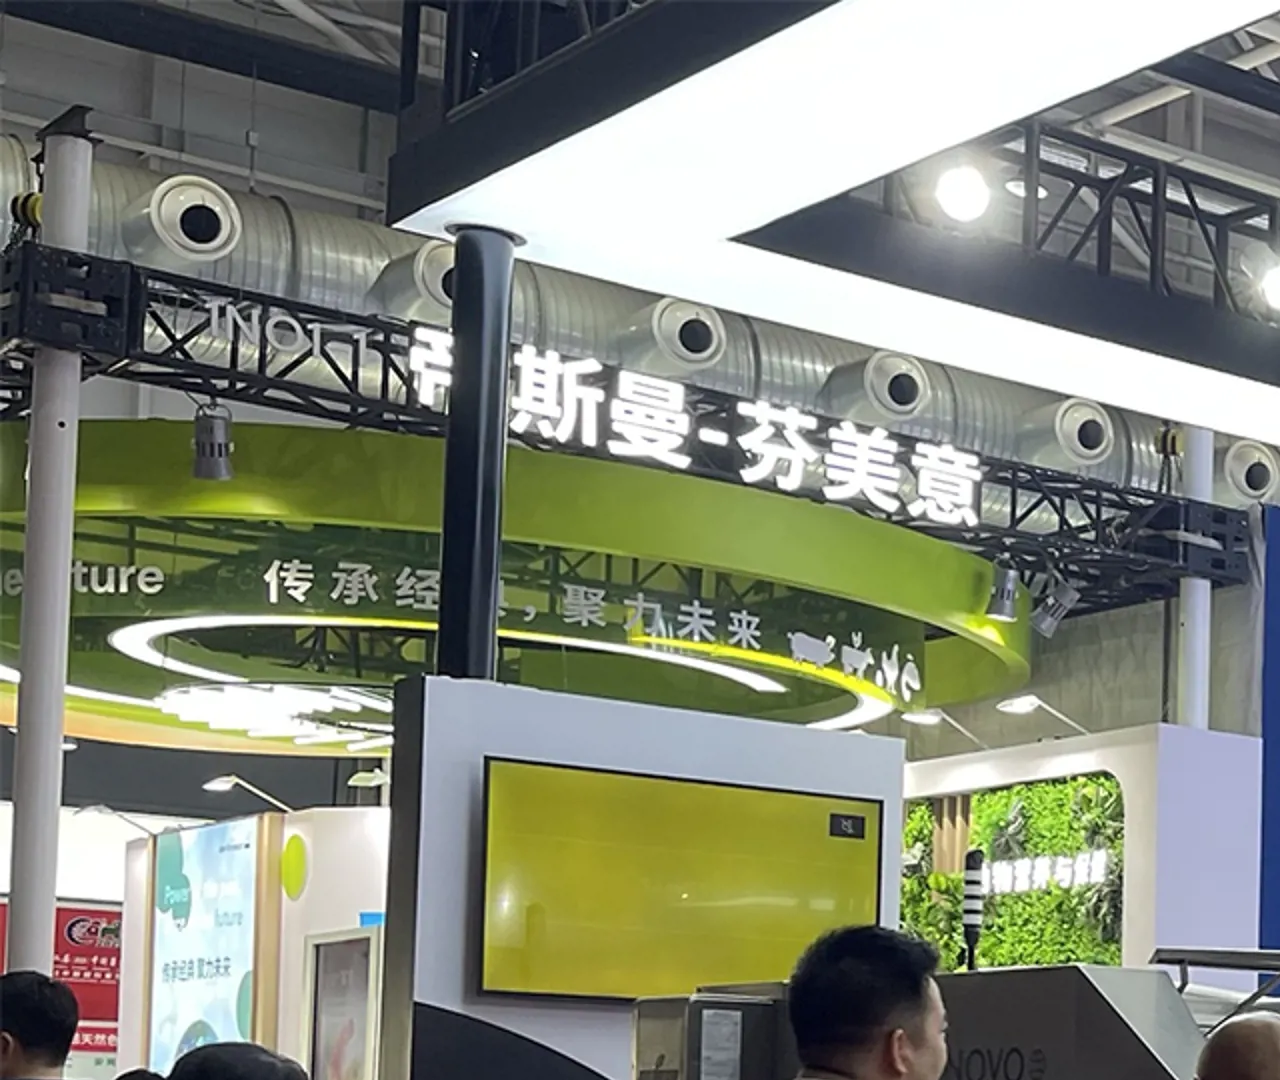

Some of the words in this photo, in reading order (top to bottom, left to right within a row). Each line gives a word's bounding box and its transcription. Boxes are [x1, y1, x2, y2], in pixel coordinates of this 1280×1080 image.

[73, 562, 164, 595] ture
[264, 558, 762, 651] 传承经，聚力未来
